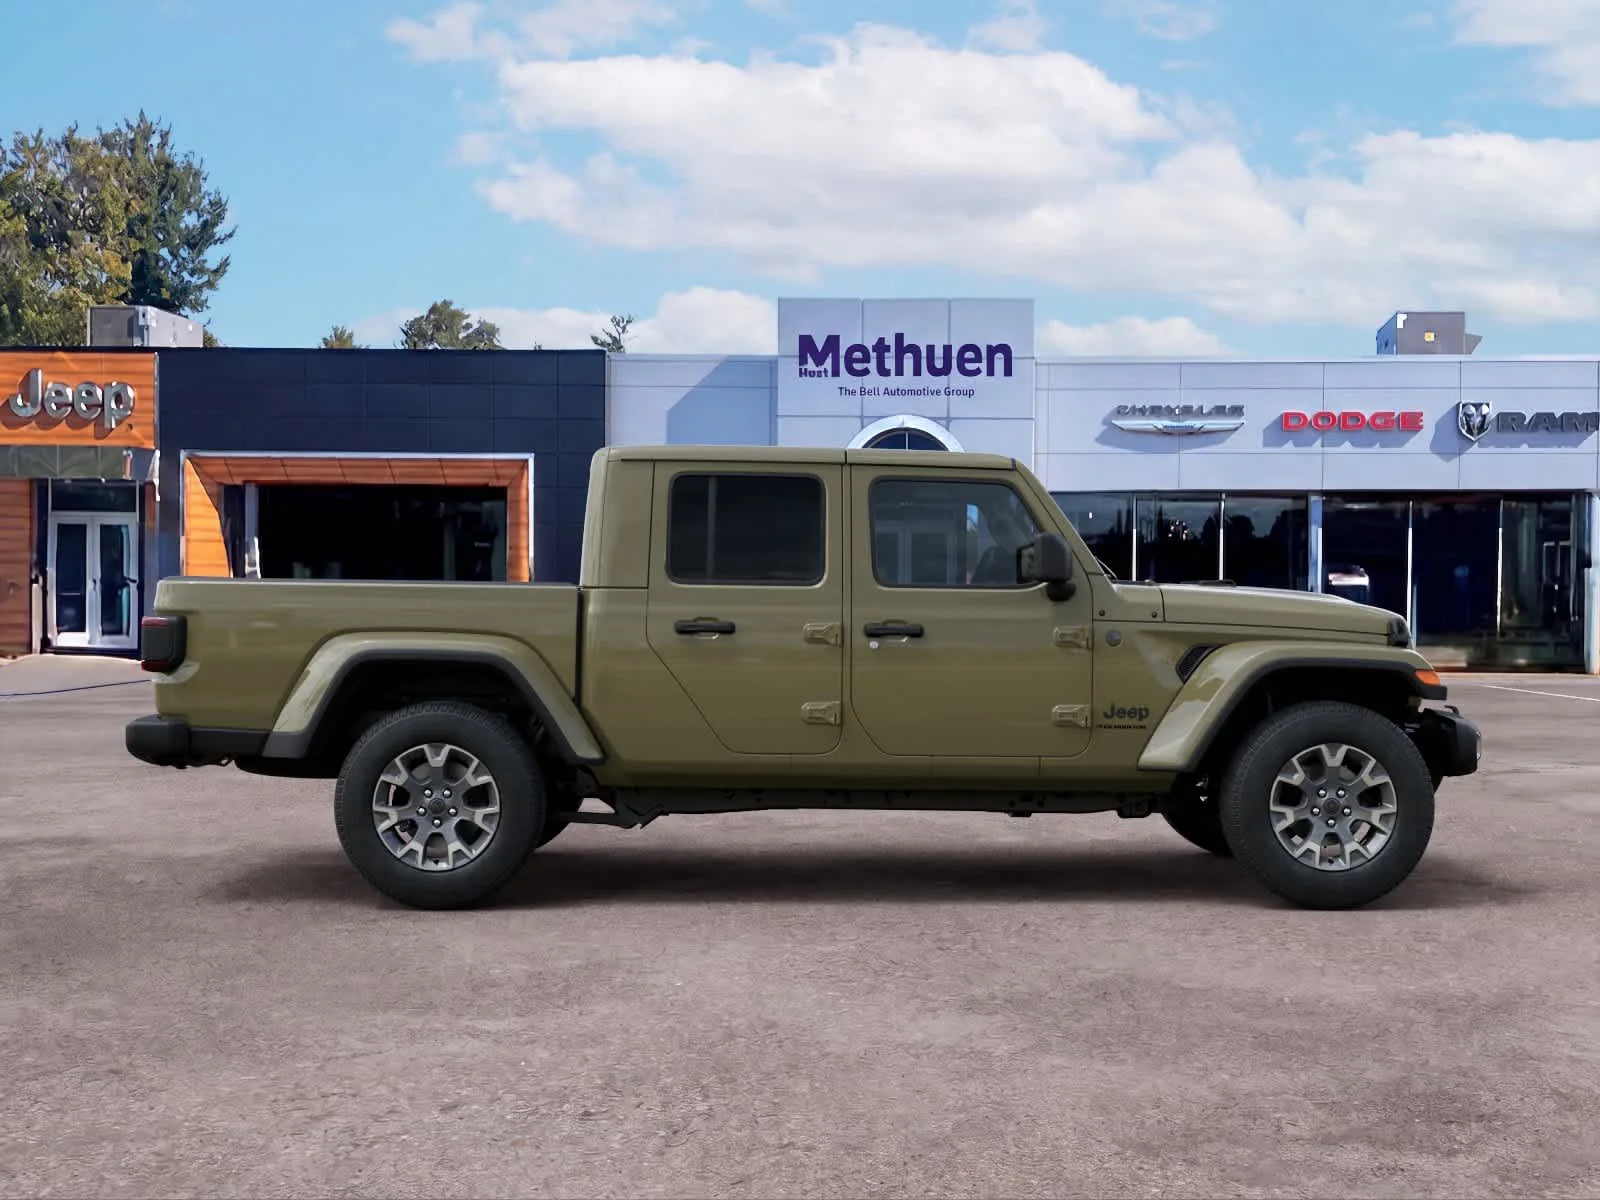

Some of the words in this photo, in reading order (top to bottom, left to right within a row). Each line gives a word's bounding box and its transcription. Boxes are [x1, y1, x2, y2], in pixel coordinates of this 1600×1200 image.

[799, 333, 1013, 378] Methuen
[9, 368, 136, 429] Jeep
[838, 387, 857, 397] The
[859, 387, 880, 397] Bell
[883, 387, 942, 397] Automotive
[944, 387, 975, 399] Group
[1282, 411, 1424, 431] DODGE
[1496, 411, 1600, 432] RAM
[1103, 702, 1150, 721] Jeep
